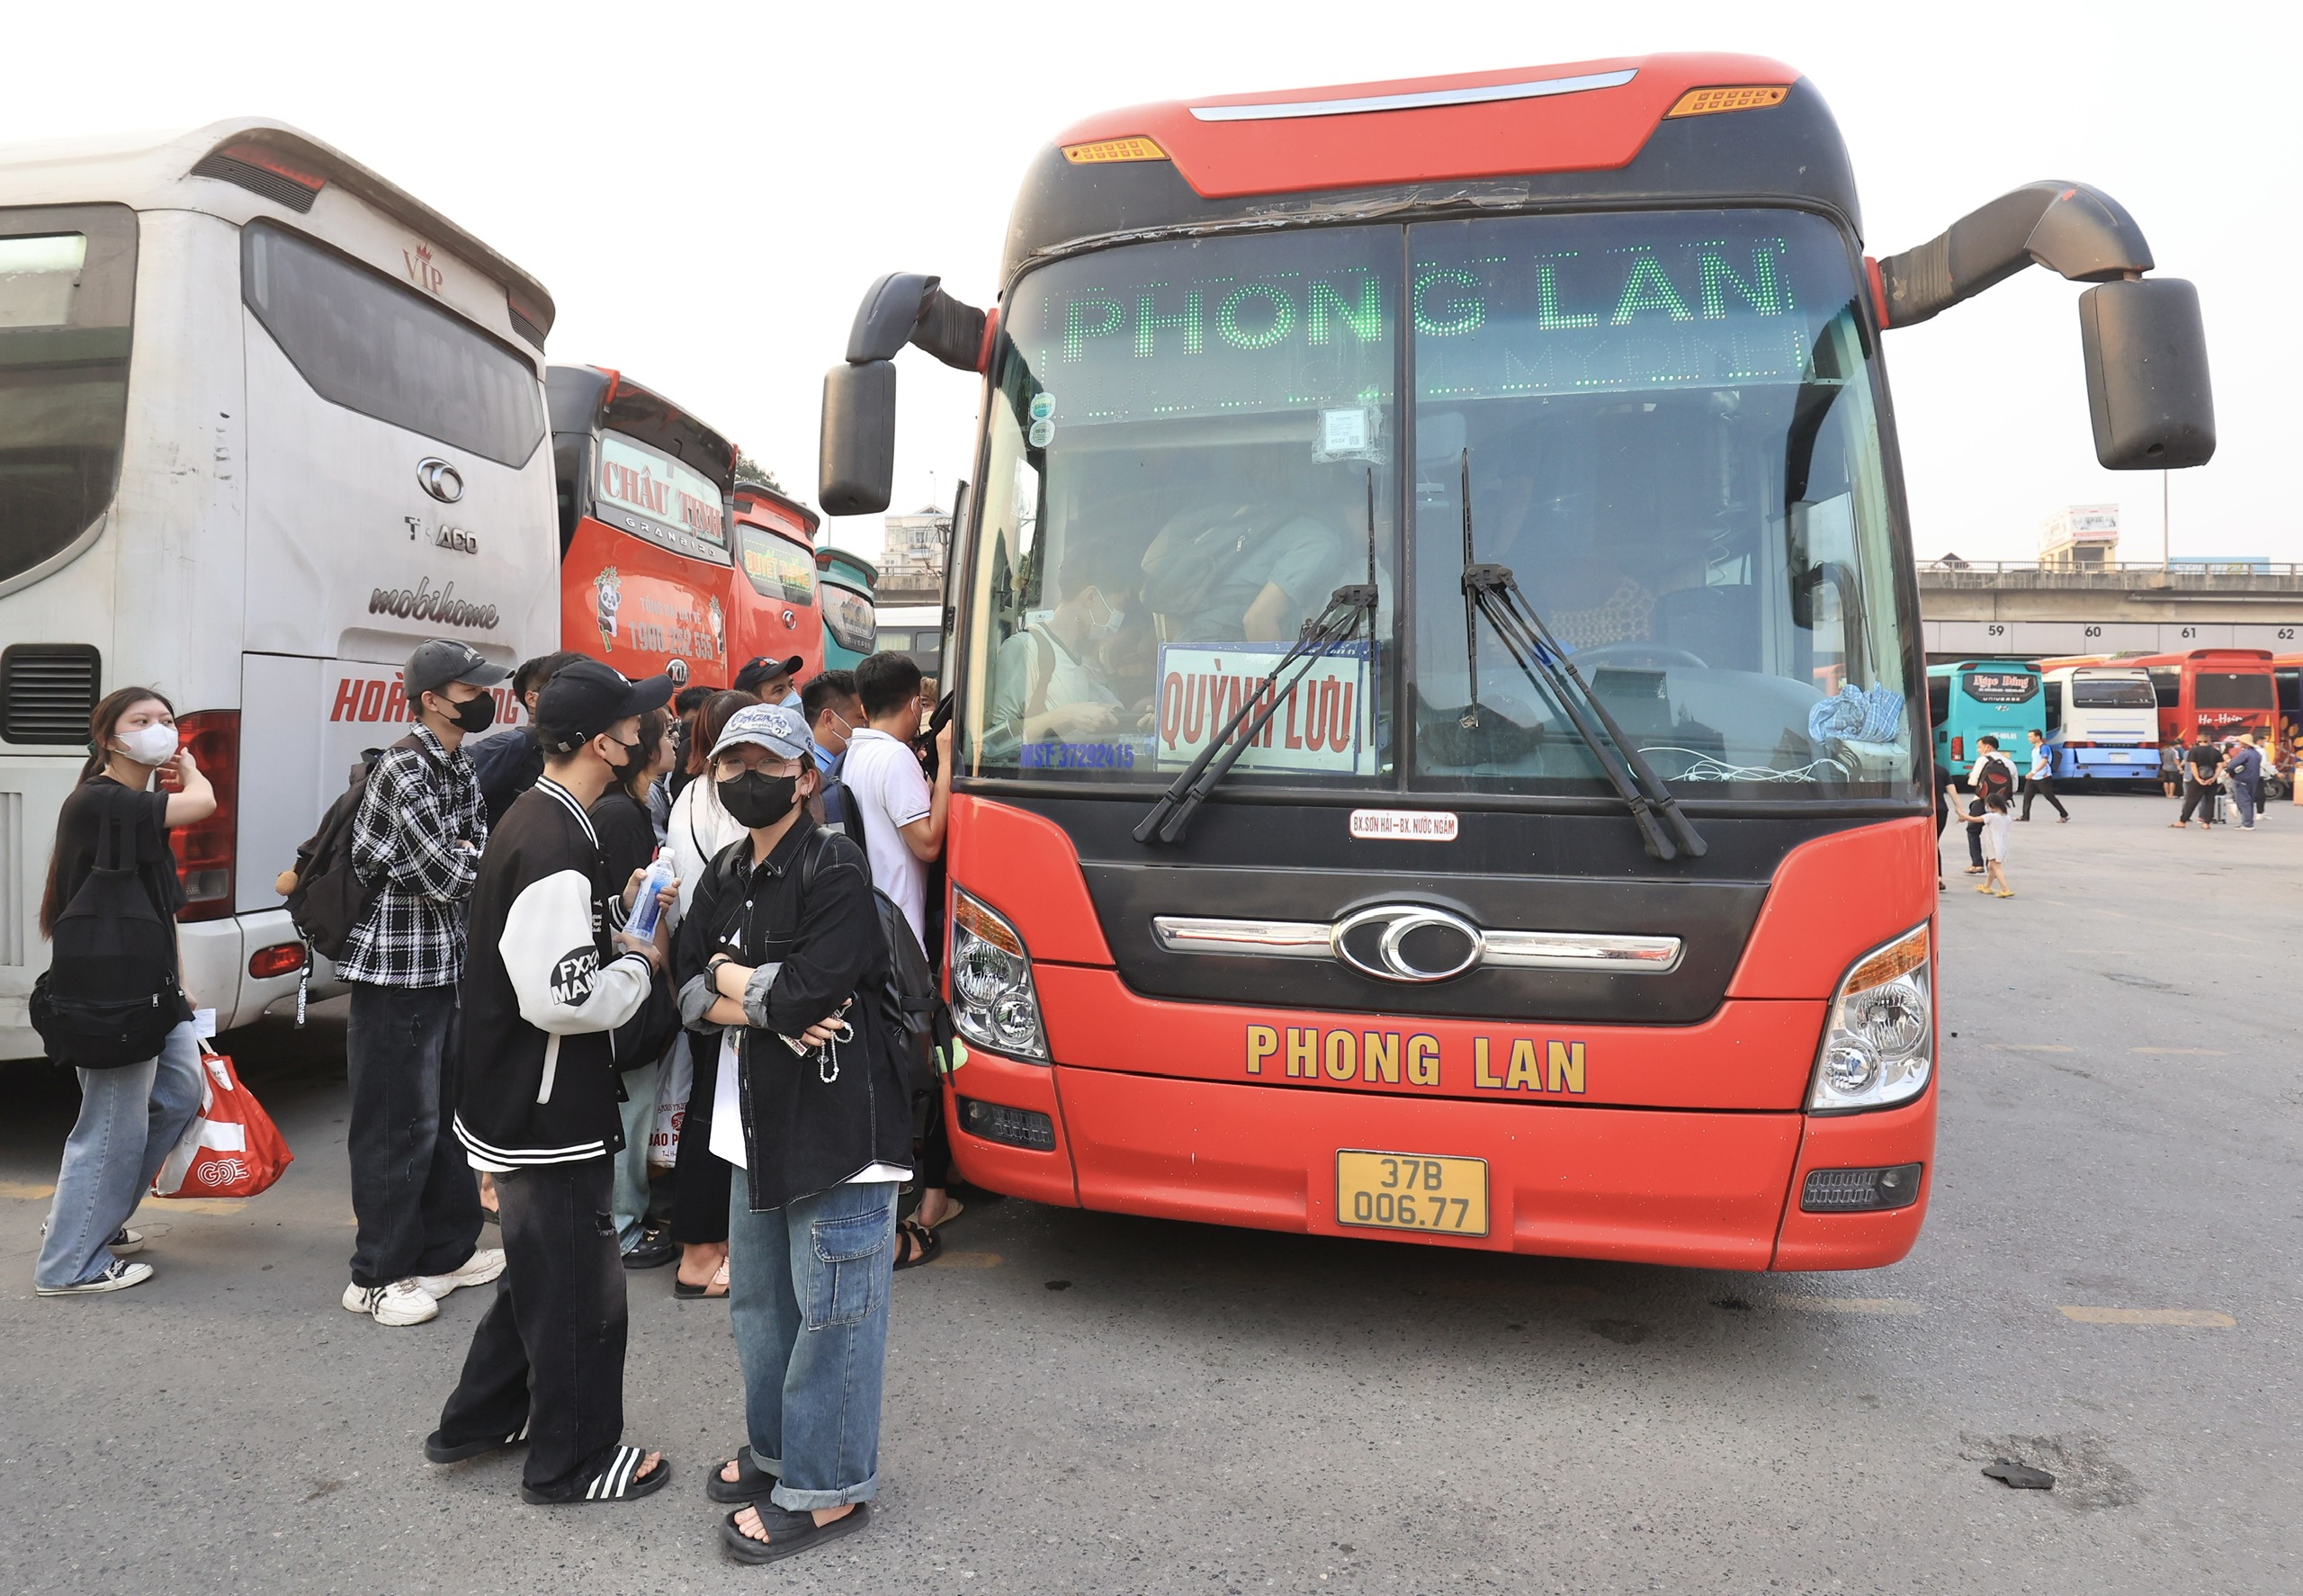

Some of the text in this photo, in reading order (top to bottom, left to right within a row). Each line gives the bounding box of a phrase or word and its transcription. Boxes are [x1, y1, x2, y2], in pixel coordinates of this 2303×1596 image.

[402, 248, 443, 296] VIP
[1063, 247, 1782, 363] PHONG LAN
[602, 460, 670, 517] CHÂU
[625, 517, 716, 557] GRANBIRD
[368, 576, 499, 630] mobihome
[694, 631, 713, 660] 555
[1988, 625, 2004, 636] 59
[2084, 626, 2101, 637] 60
[2182, 627, 2196, 638] 61
[2278, 628, 2294, 640] 62
[671, 665, 688, 682] KIA
[1160, 659, 1353, 754] QUỲNH LƯU
[1246, 1024, 1586, 1095] PHONG LAN
[1380, 1158, 1443, 1192] 37B
[1354, 1190, 1470, 1229] 006.77
